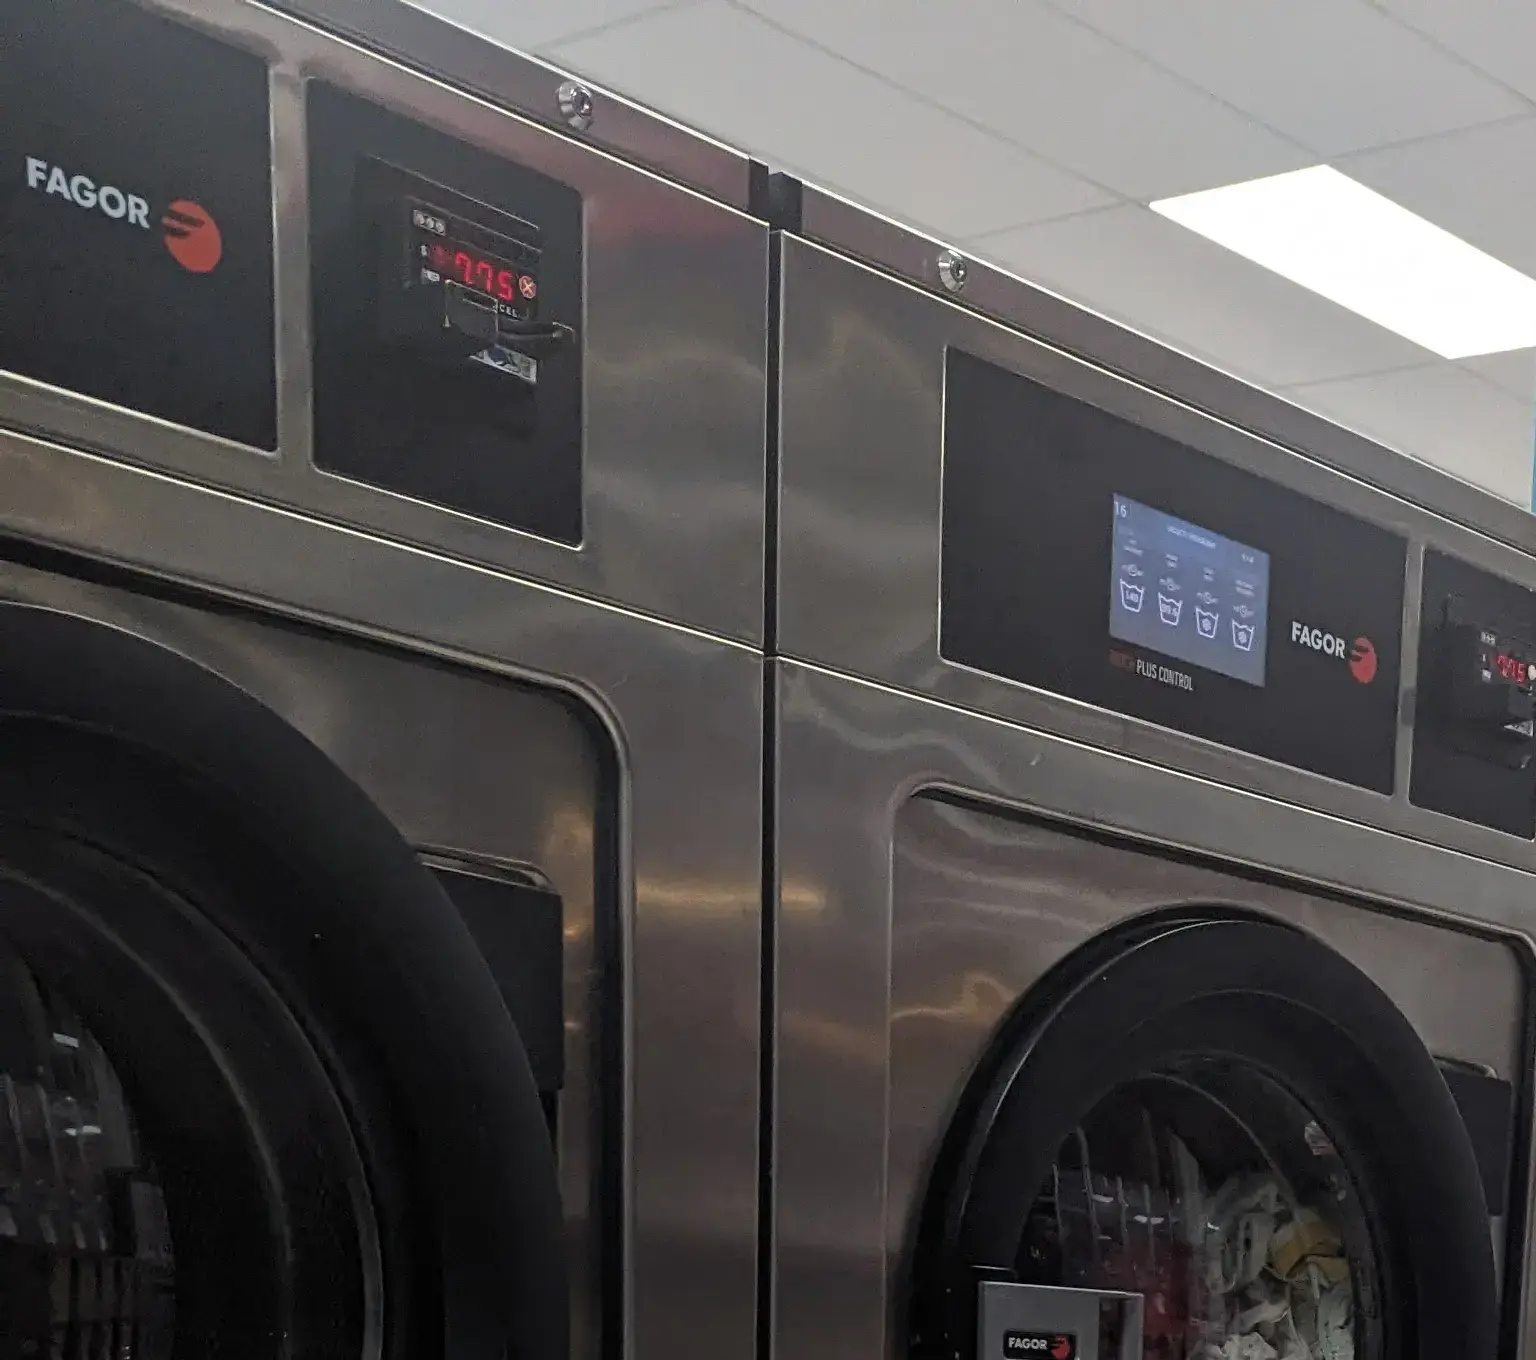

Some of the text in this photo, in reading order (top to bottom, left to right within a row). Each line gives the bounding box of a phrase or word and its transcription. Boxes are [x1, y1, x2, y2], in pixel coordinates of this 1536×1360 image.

[26, 155, 150, 229] FAGOR
[1291, 620, 1346, 659] FAGOR
[1136, 658, 1157, 679] PLUS
[1158, 665, 1193, 691] CONTROL
[1008, 1337, 1048, 1350] FAGOR
